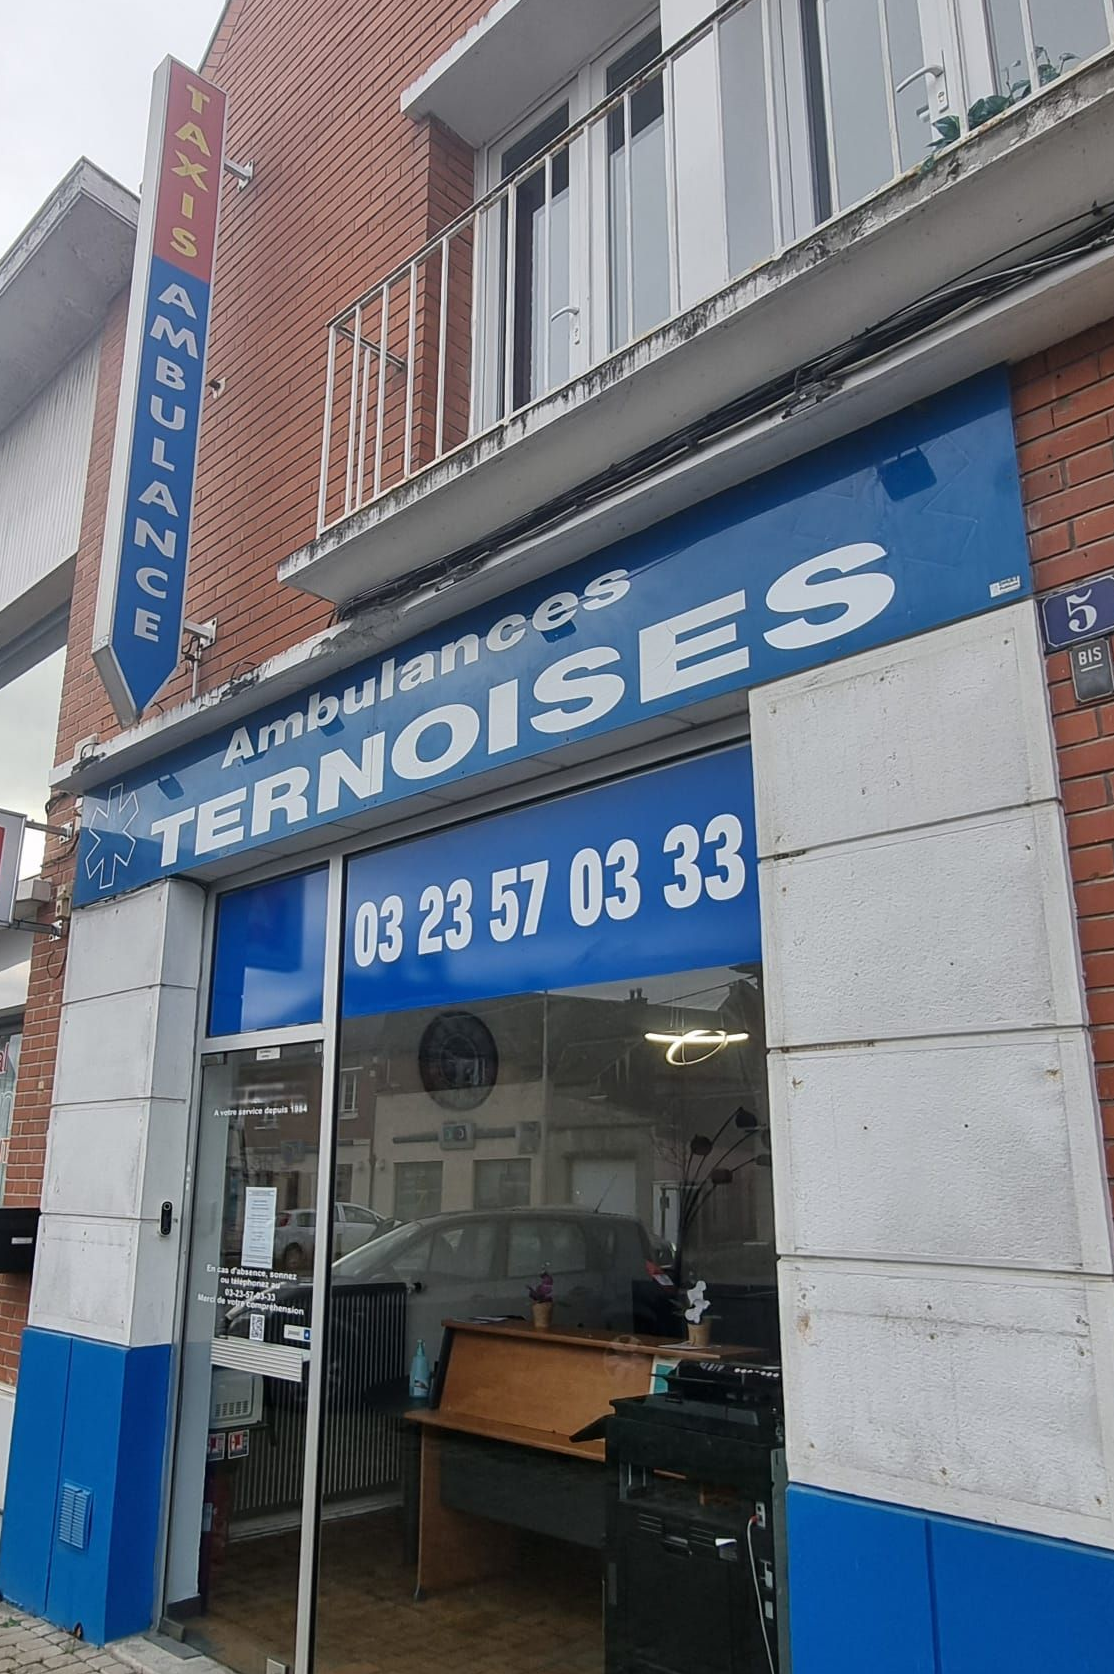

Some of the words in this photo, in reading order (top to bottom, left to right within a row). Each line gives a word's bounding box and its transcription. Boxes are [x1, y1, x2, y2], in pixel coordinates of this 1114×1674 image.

[170, 83, 212, 260] TAXIS
[133, 281, 199, 643] AMBULANCE
[1065, 588, 1098, 633] 5
[221, 568, 632, 769] Ambulances
[1078, 646, 1103, 666] BIS
[150, 541, 897, 867] TERNOISES
[354, 895, 403, 968] 03
[417, 879, 473, 955] 23
[489, 860, 550, 942] 57
[569, 838, 641, 926] 03
[662, 813, 746, 909] 33
[213, 1109, 219, 1117] A
[220, 1108, 237, 1117] votre
[239, 1106, 263, 1117] service
[264, 1104, 288, 1116] depuis
[206, 1264, 216, 1273] En
[217, 1266, 229, 1275] cas
[230, 1266, 269, 1279] d'absence,
[269, 1271, 297, 1281] sonnez
[220, 1276, 230, 1284] ou
[197, 1293, 216, 1304] Merci
[216, 1296, 227, 1305] de
[227, 1299, 245, 1308] votre
[246, 1300, 304, 1315] compréhension
[224, 1288, 276, 1301] 03-23-57-03-33
